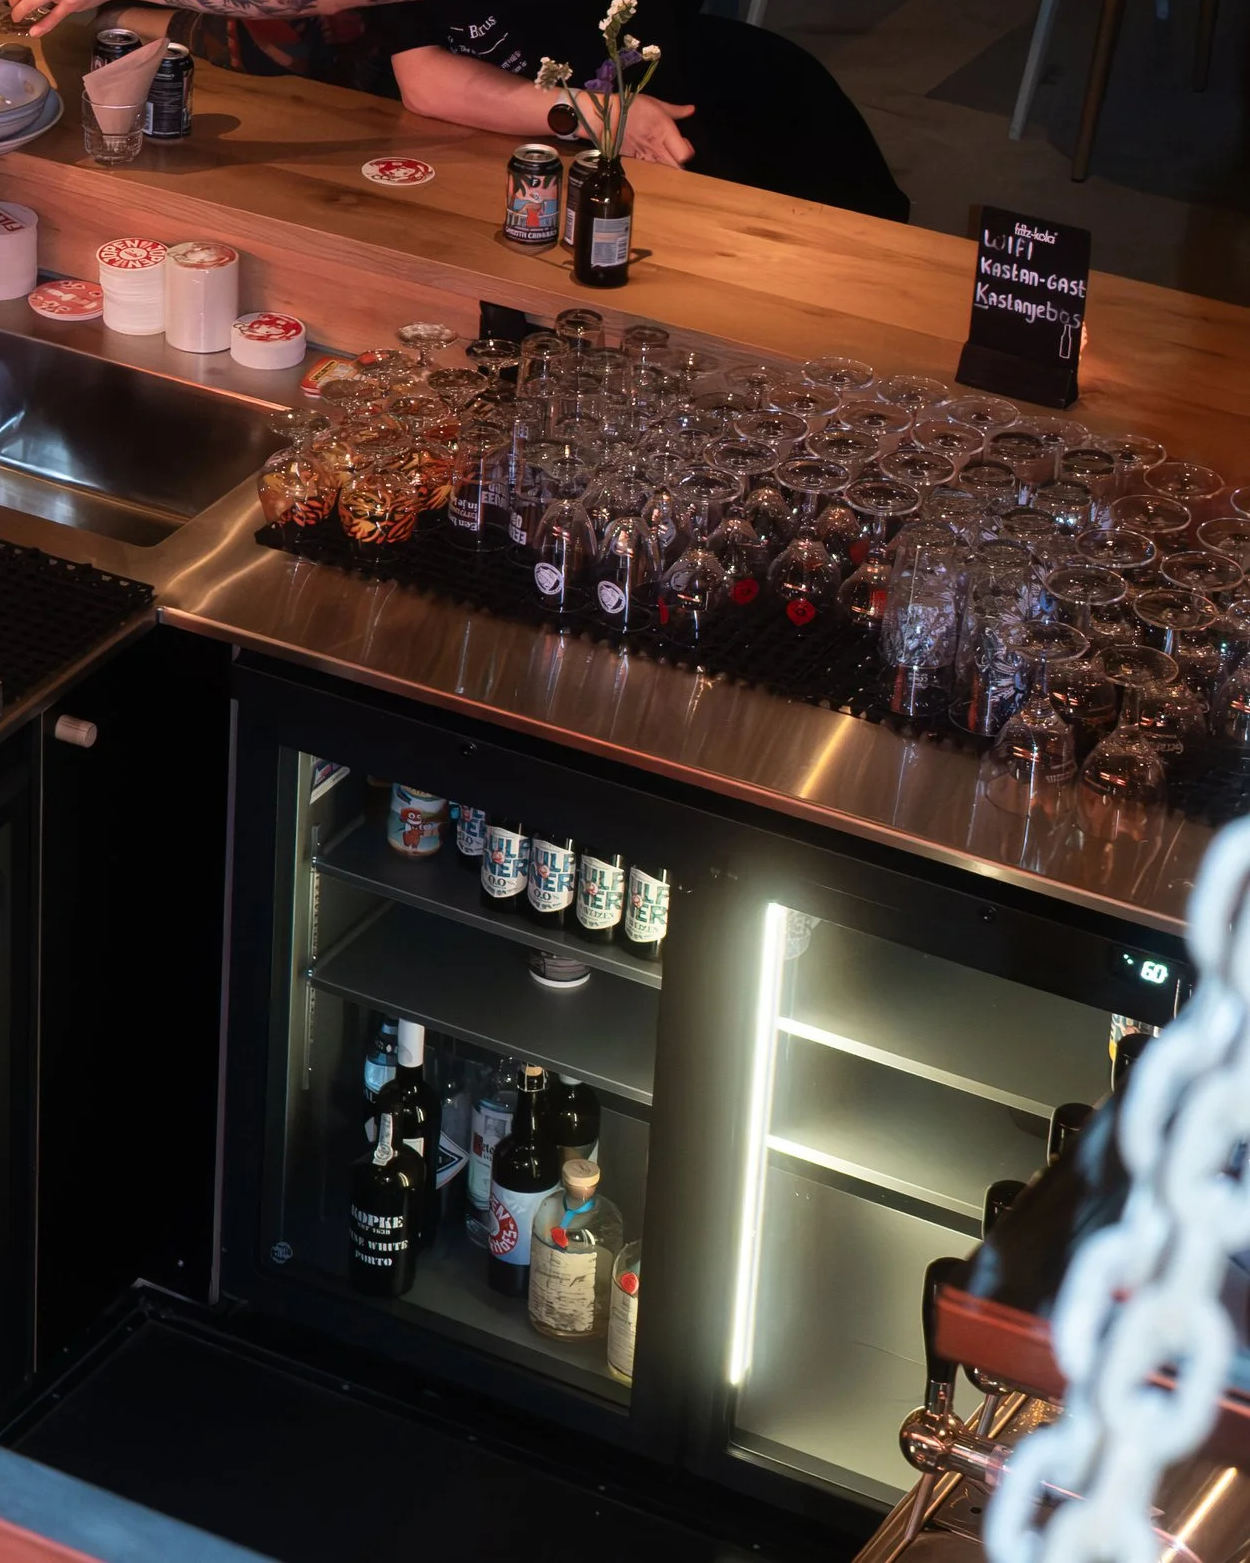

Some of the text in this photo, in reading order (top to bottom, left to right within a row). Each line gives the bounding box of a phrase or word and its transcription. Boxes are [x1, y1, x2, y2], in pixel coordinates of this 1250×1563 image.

[468, 15, 497, 39] Brus
[351, 1203, 404, 1229] KOPKE
[368, 1239, 409, 1252] WHITE
[355, 1249, 393, 1267] PORTO
